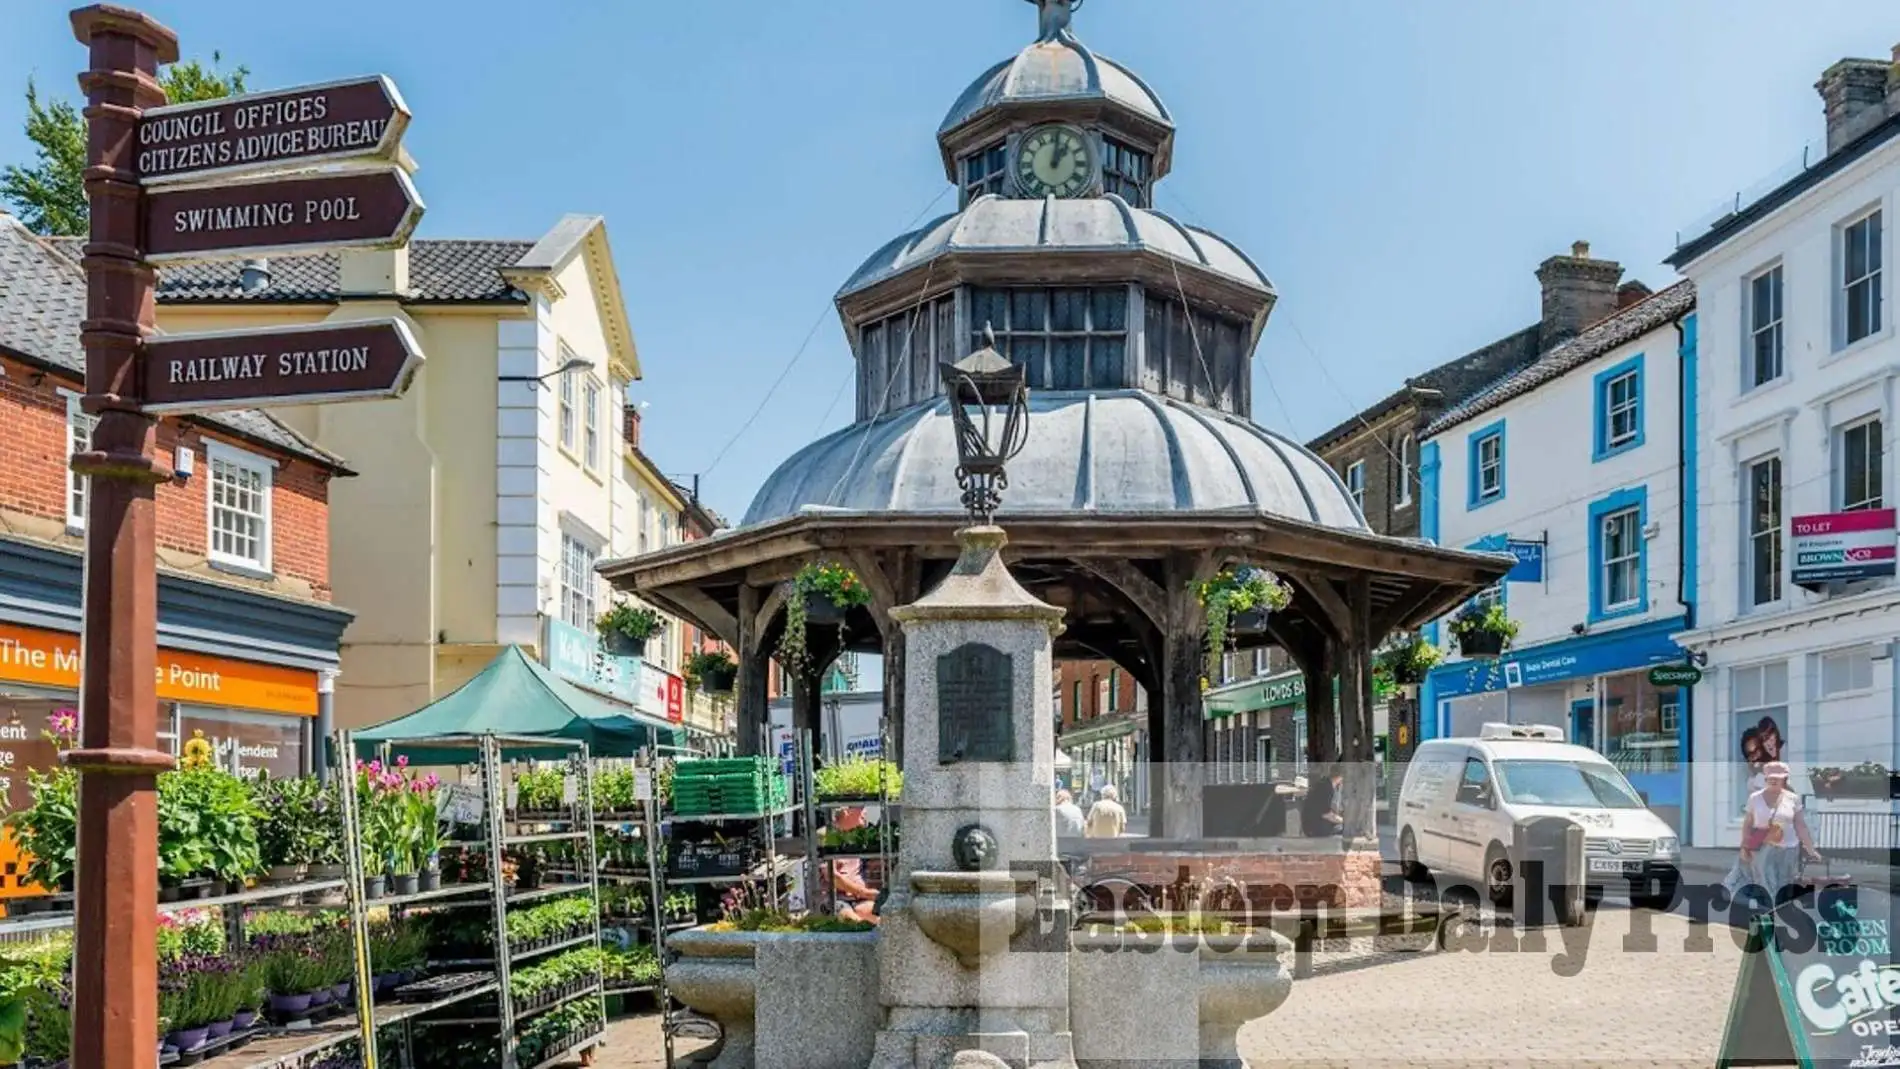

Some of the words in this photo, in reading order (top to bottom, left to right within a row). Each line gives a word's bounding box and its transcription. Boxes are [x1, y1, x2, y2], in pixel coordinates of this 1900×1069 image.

[139, 111, 226, 145] COUNCIL
[234, 96, 327, 130] OFFICES
[138, 140, 231, 174] CITIZENS
[234, 130, 304, 158] ADVICE
[306, 119, 387, 149] BUREAU
[174, 202, 294, 233] SWIMMING
[304, 196, 361, 223] POOL
[169, 354, 268, 384] RAILWAY
[278, 346, 369, 376] STATION
[1796, 523, 1811, 534] TO
[1812, 521, 1832, 532] LET
[0, 638, 46, 668] The
[169, 663, 221, 691] Point
[1653, 670, 1697, 681] Specsavers
[1260, 682, 1292, 702] LLOYDS
[1817, 919, 1888, 939] GREEN
[1824, 937, 1892, 957] ROOM
[1851, 1019, 1900, 1037] OPE
